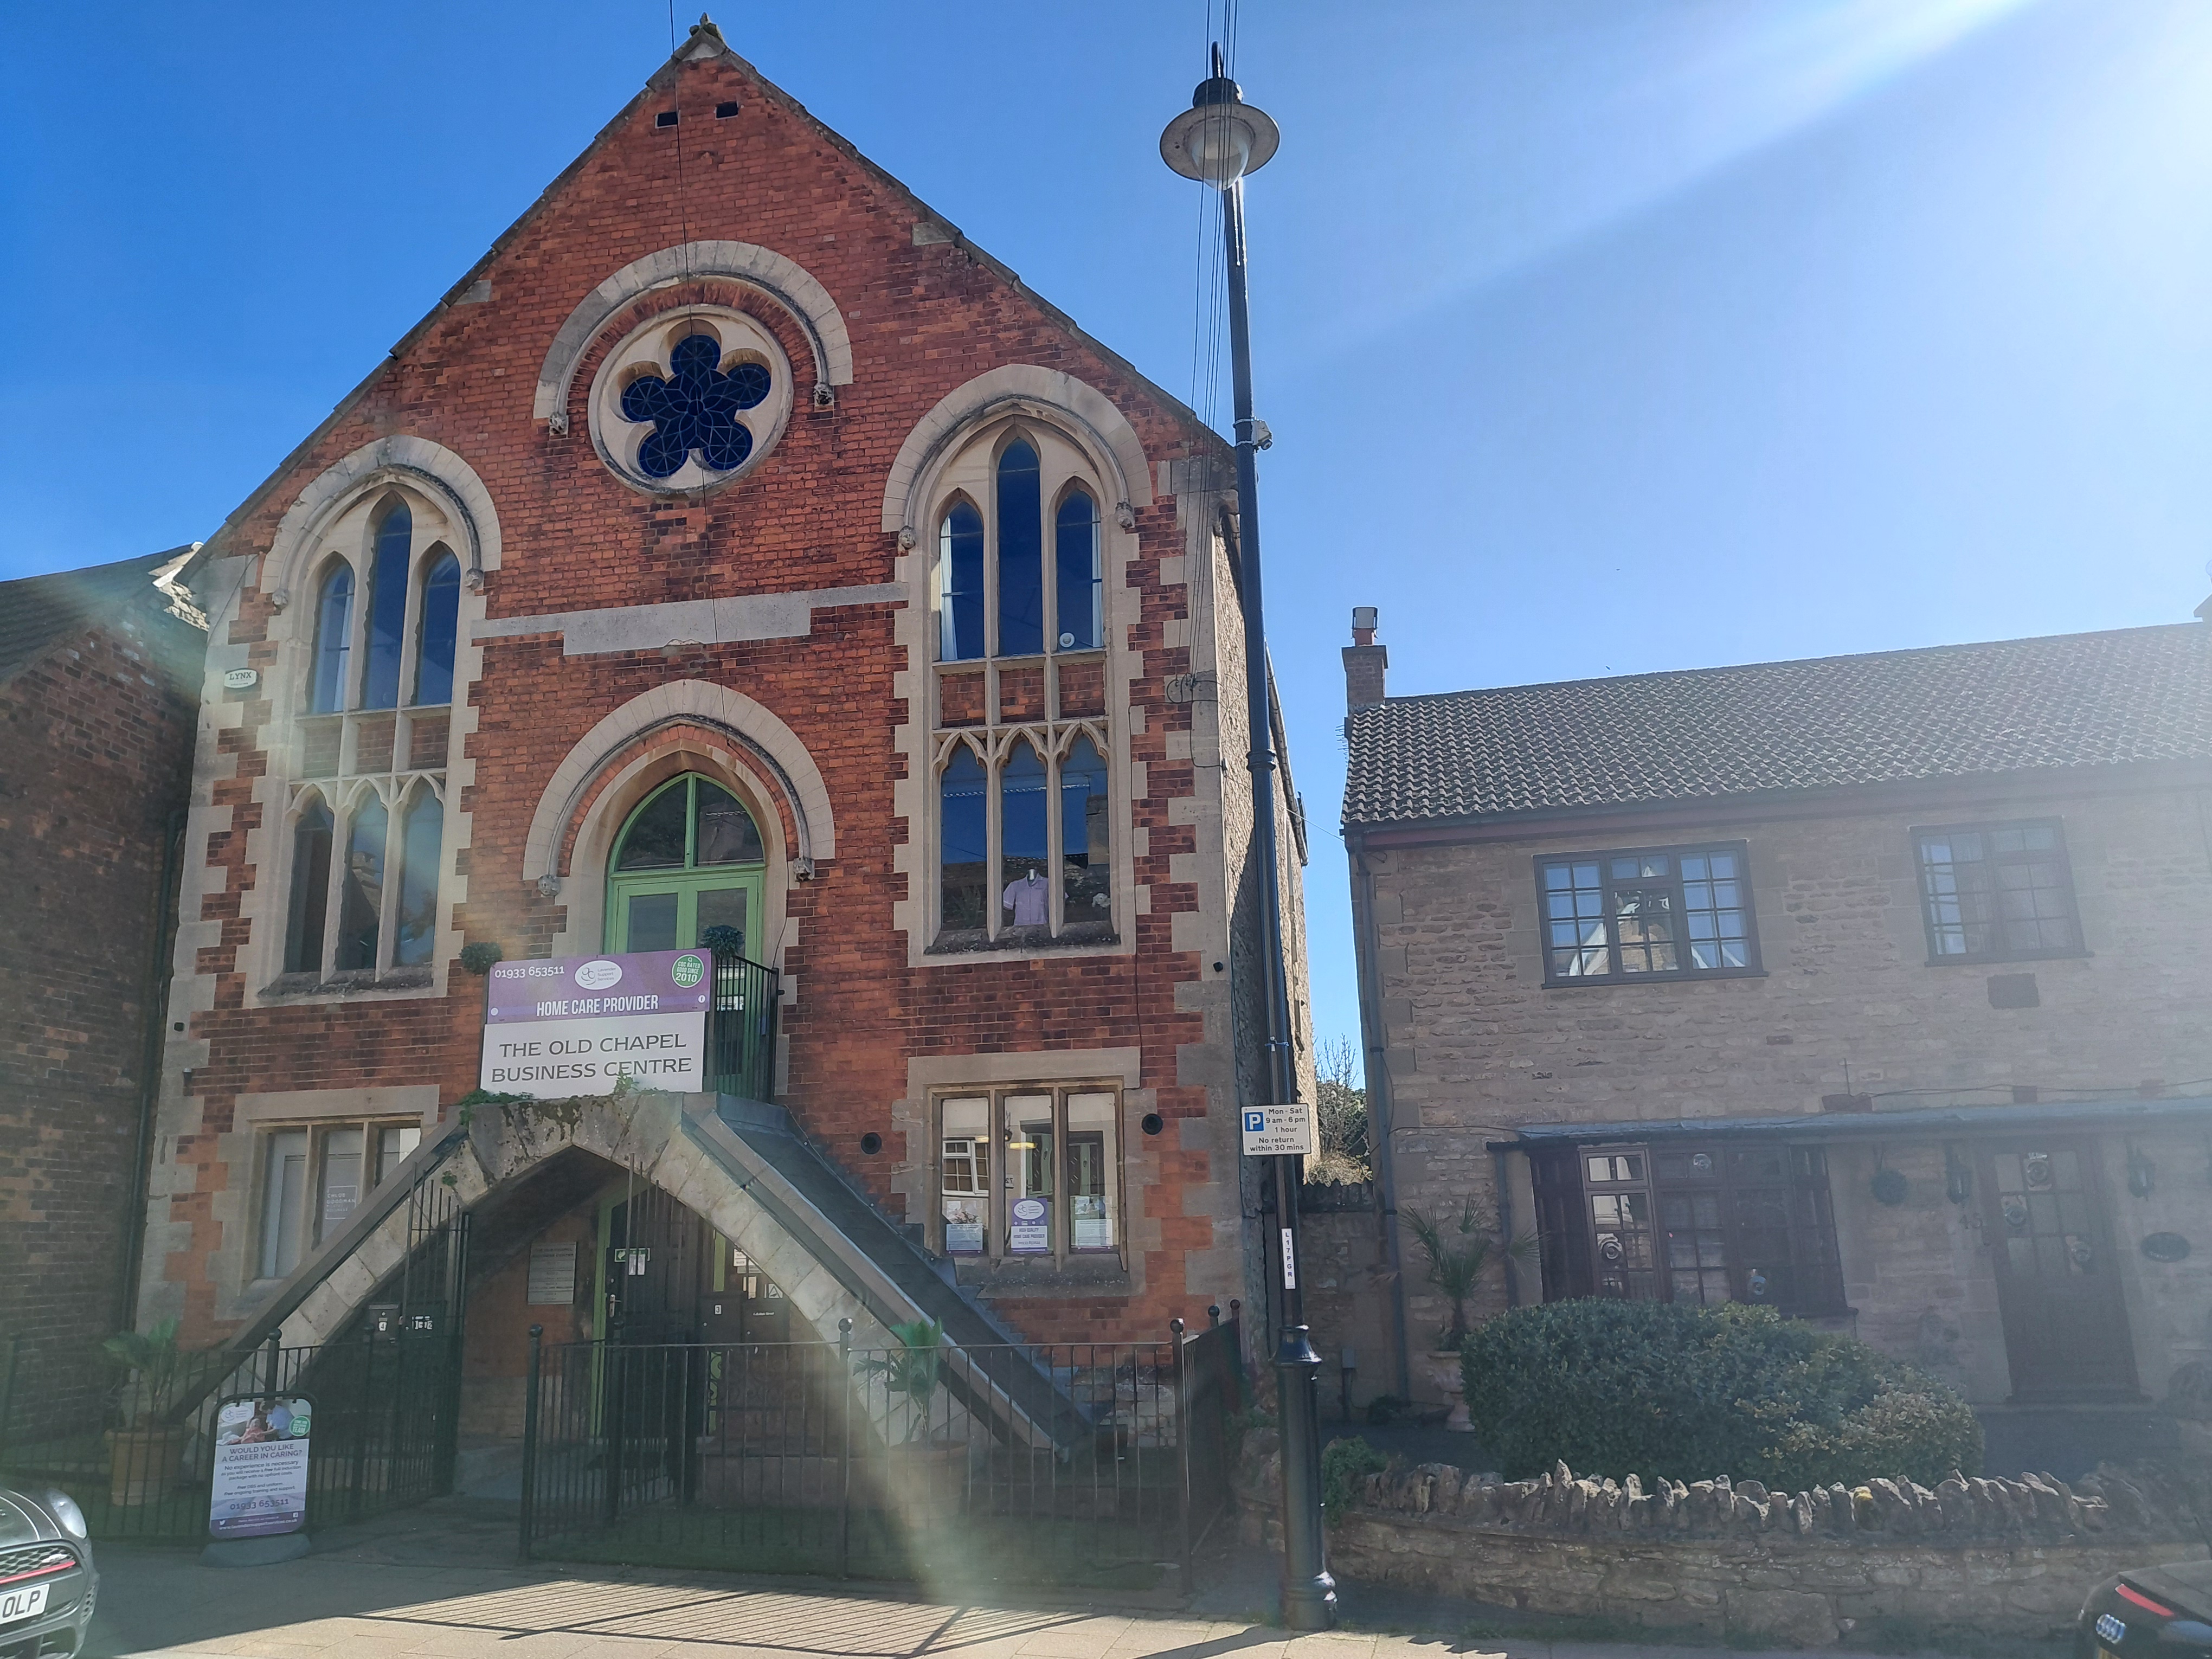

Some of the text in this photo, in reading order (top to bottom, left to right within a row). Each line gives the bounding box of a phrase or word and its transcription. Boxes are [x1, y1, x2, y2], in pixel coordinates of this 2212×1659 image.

[229, 672, 252, 680] LYNX
[494, 966, 564, 978] 01933 653511
[676, 973, 697, 982] 2010
[536, 994, 659, 1017] HOME CARE PROVIDER
[499, 1033, 687, 1058] THE OLD CHAPEL
[491, 1058, 692, 1082] BUSINESS CENTRE
[1249, 1114, 1261, 1130] P
[229, 1454, 259, 1462] CAREER
[271, 1450, 303, 1458] CARING?
[259, 1499, 289, 1507] 653511
[3, 1590, 41, 1618] OLP
